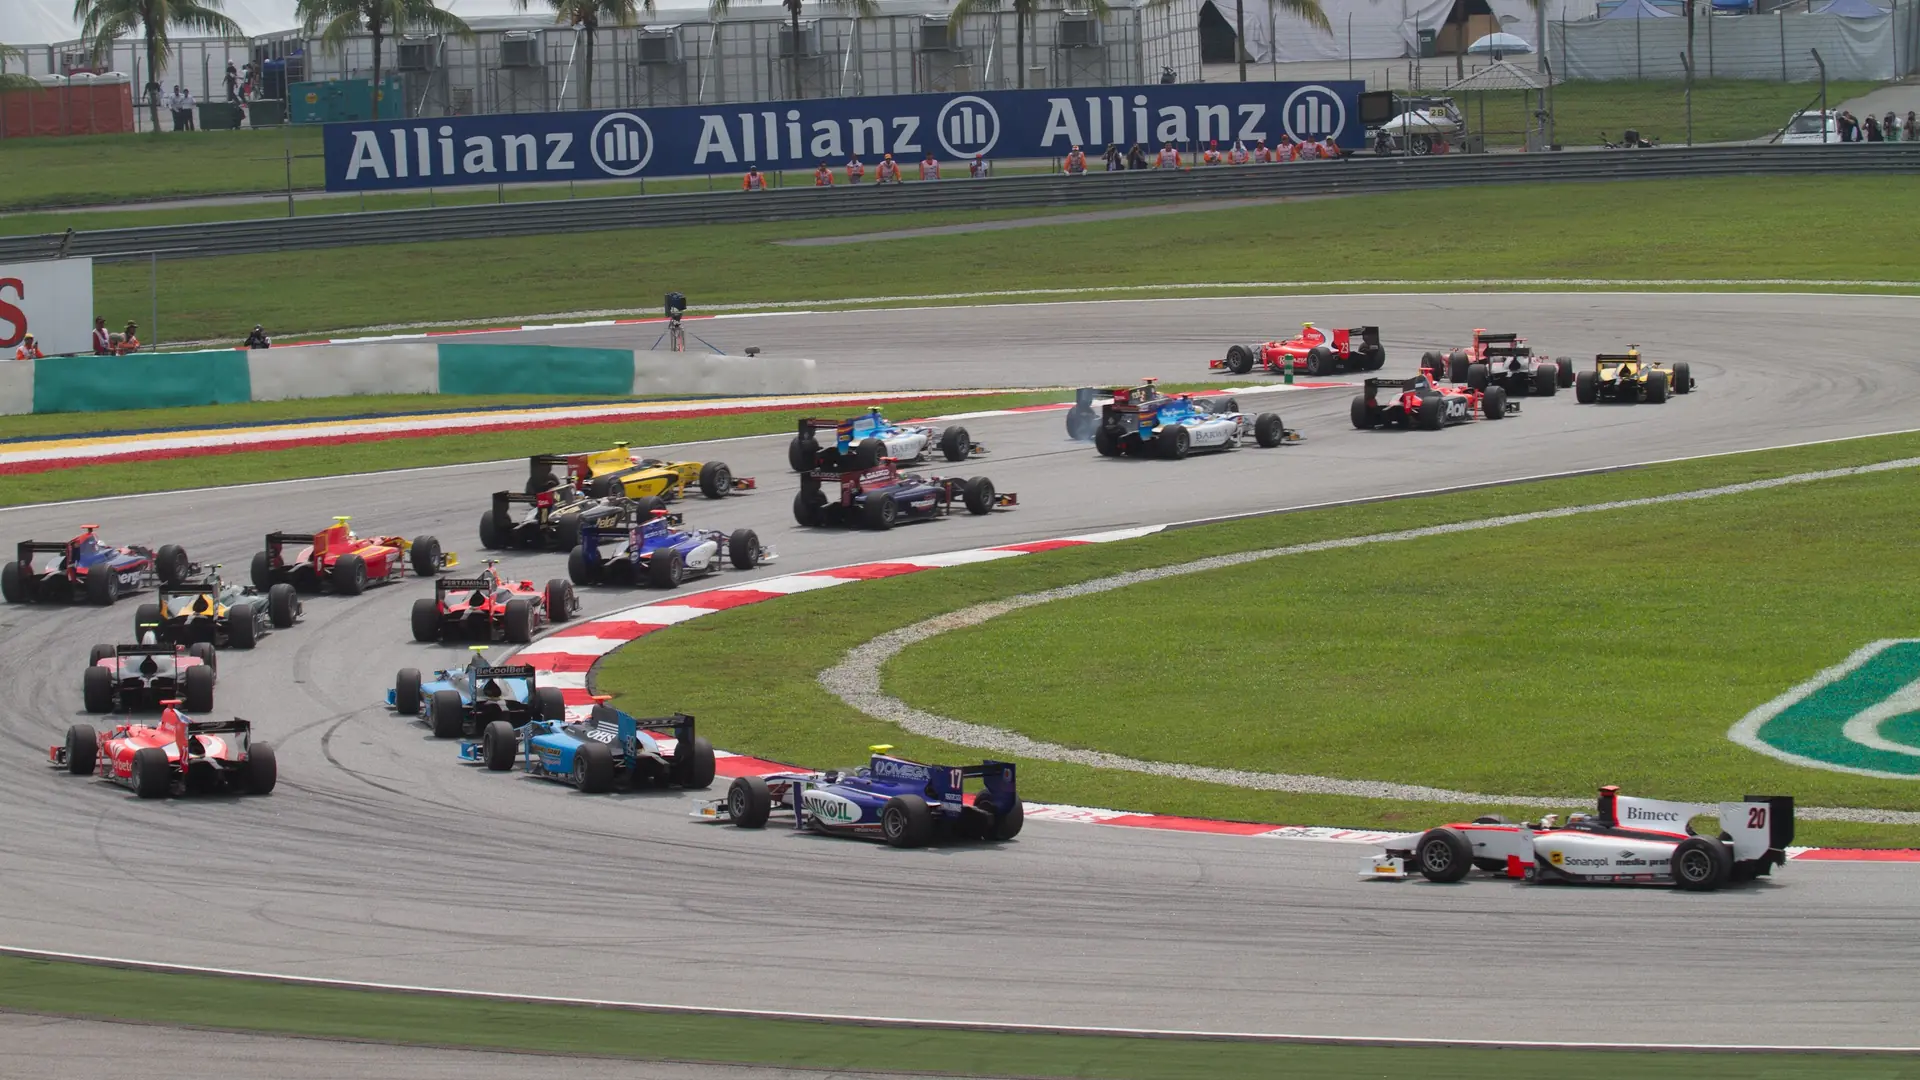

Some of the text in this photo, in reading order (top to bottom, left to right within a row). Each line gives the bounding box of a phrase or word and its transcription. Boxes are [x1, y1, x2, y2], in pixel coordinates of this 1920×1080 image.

[1040, 94, 1267, 147] Allianz
[694, 109, 922, 165] Allianz
[345, 125, 575, 180] Allianz
[1340, 342, 1349, 353] 23
[476, 666, 525, 676] BeCoolBet
[950, 769, 962, 789] 17
[1627, 806, 1679, 822] Bimecc
[1747, 807, 1766, 829] 20
[1565, 856, 1609, 868] Sonangol
